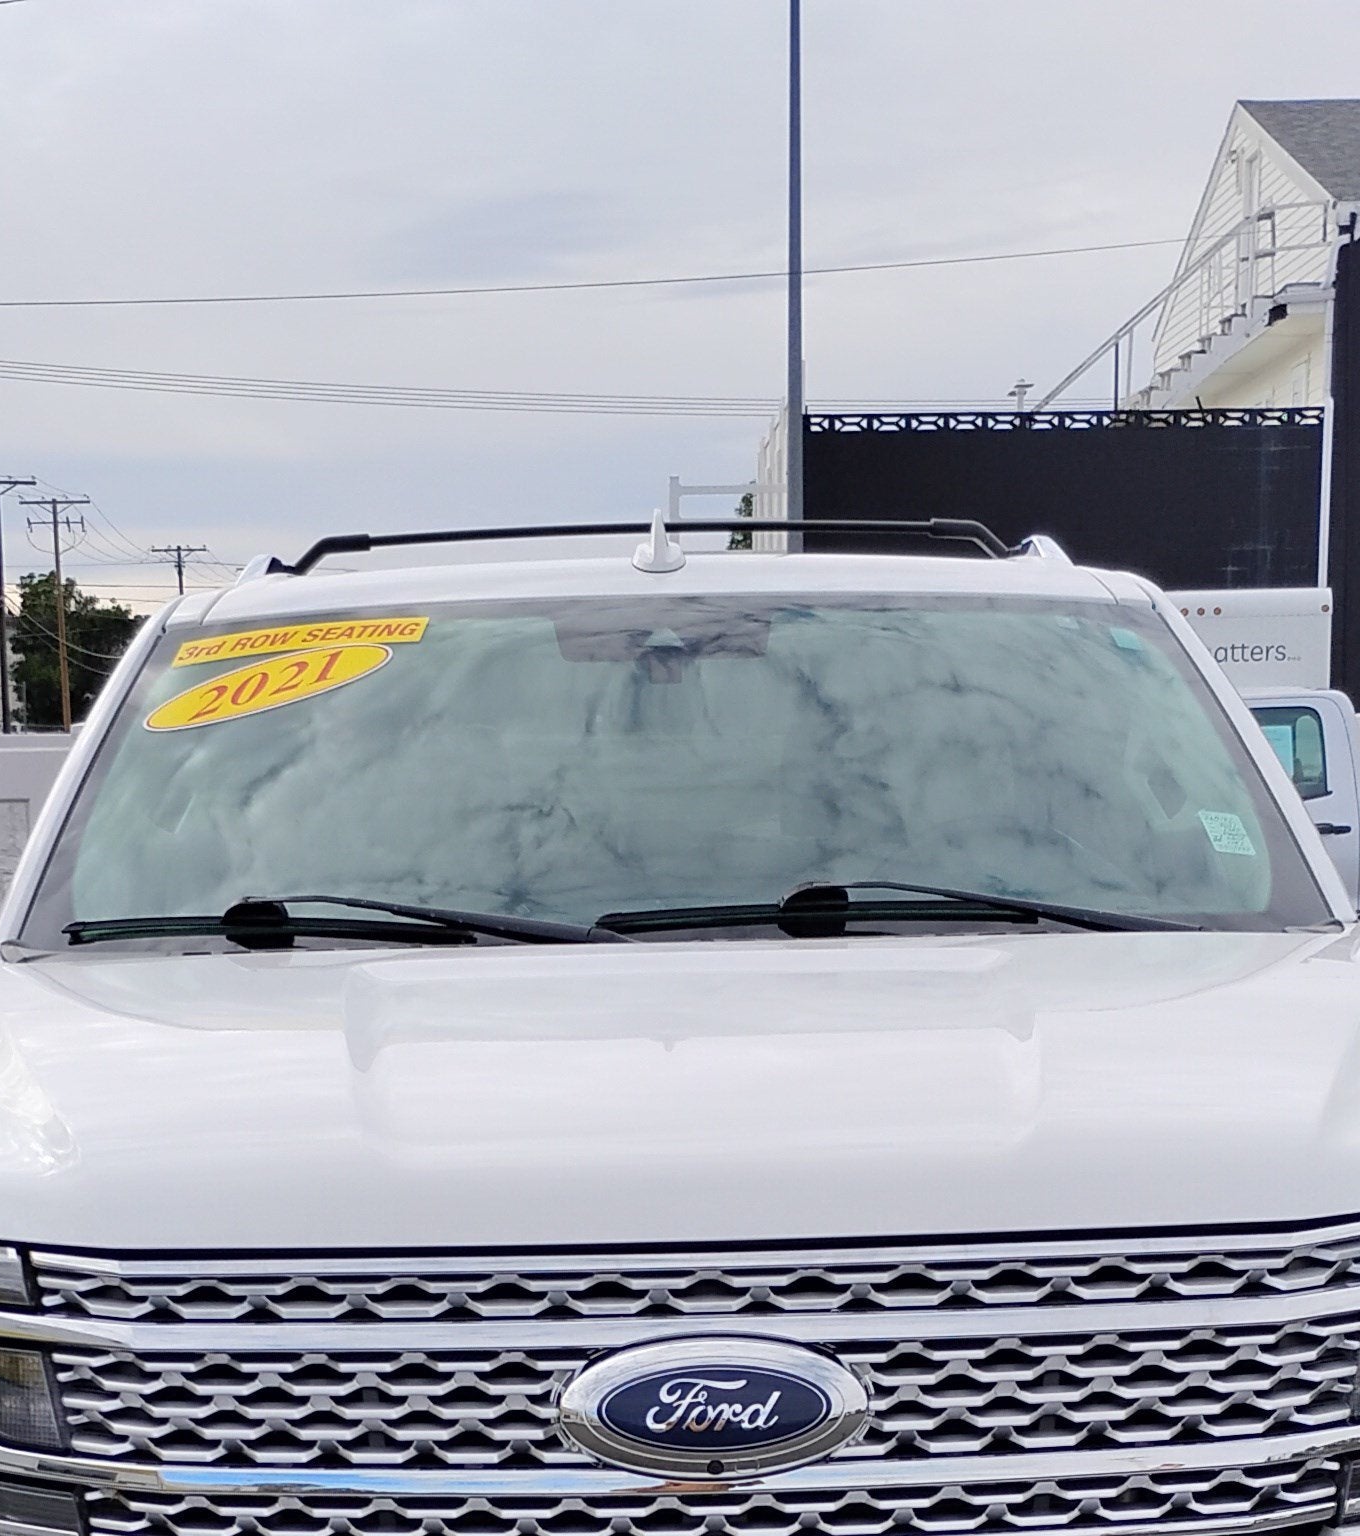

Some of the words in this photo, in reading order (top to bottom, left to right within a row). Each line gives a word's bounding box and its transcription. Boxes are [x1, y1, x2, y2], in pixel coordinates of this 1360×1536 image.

[177, 640, 223, 661] 3rd
[229, 631, 298, 653] ROW
[301, 622, 421, 643] SEATING
[1209, 643, 1287, 663] atters
[188, 650, 343, 721] 2021
[645, 1377, 782, 1433] Ford
